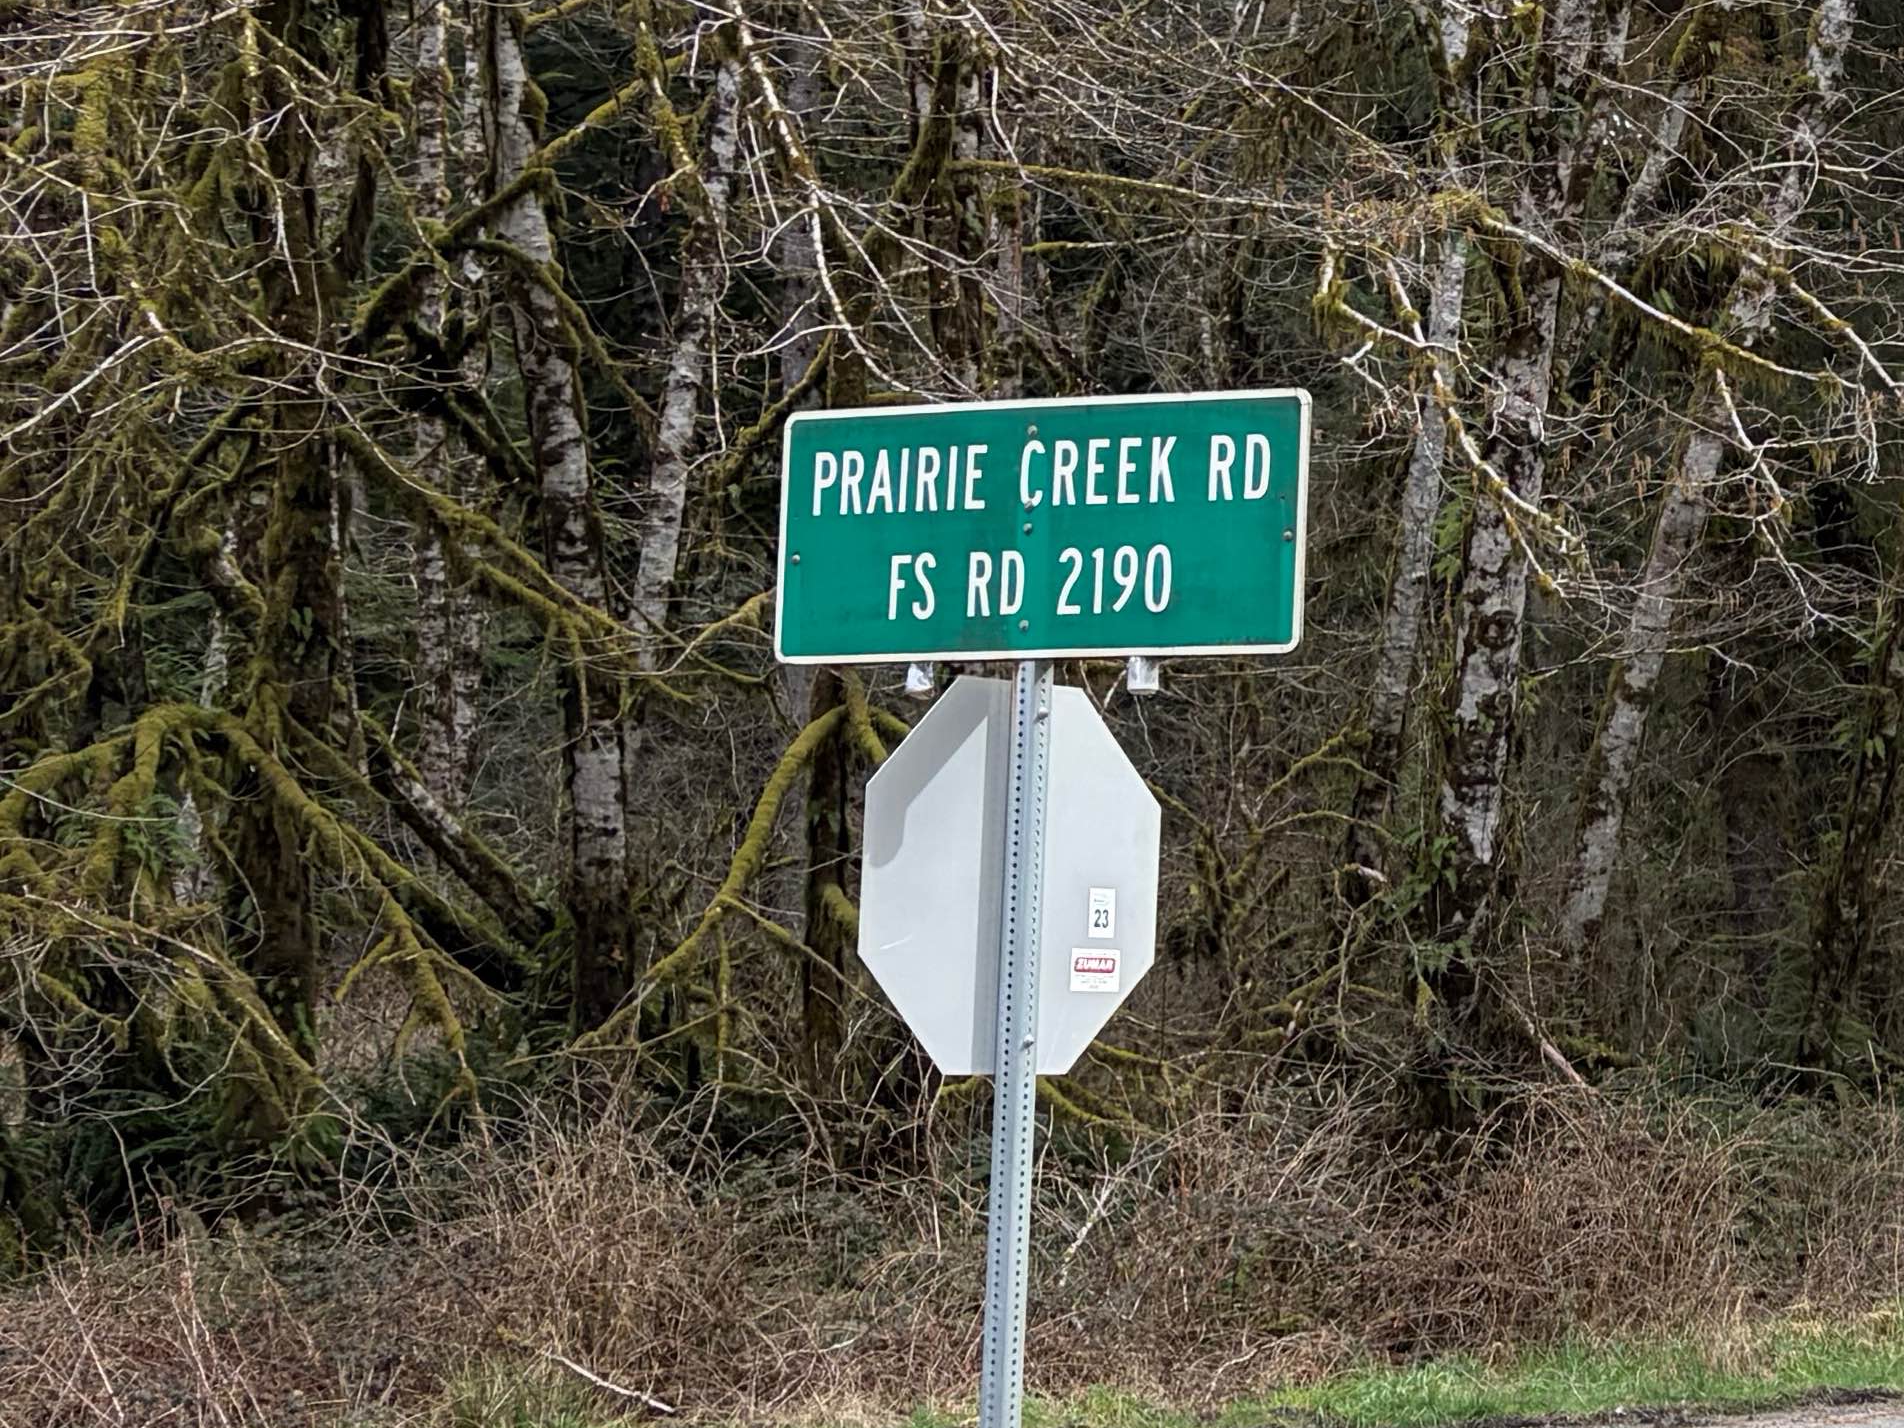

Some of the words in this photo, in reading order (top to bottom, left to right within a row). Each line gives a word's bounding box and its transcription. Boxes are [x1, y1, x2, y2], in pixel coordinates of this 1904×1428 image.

[811, 444, 989, 517] PRAIRIE
[1019, 435, 1178, 508] CREEK
[1207, 433, 1272, 502] RD
[887, 552, 937, 621] FS
[966, 549, 1025, 618] RD
[1055, 543, 1173, 616] 2190
[1094, 908, 1109, 928] 23
[1075, 957, 1115, 971] ZUMAR
